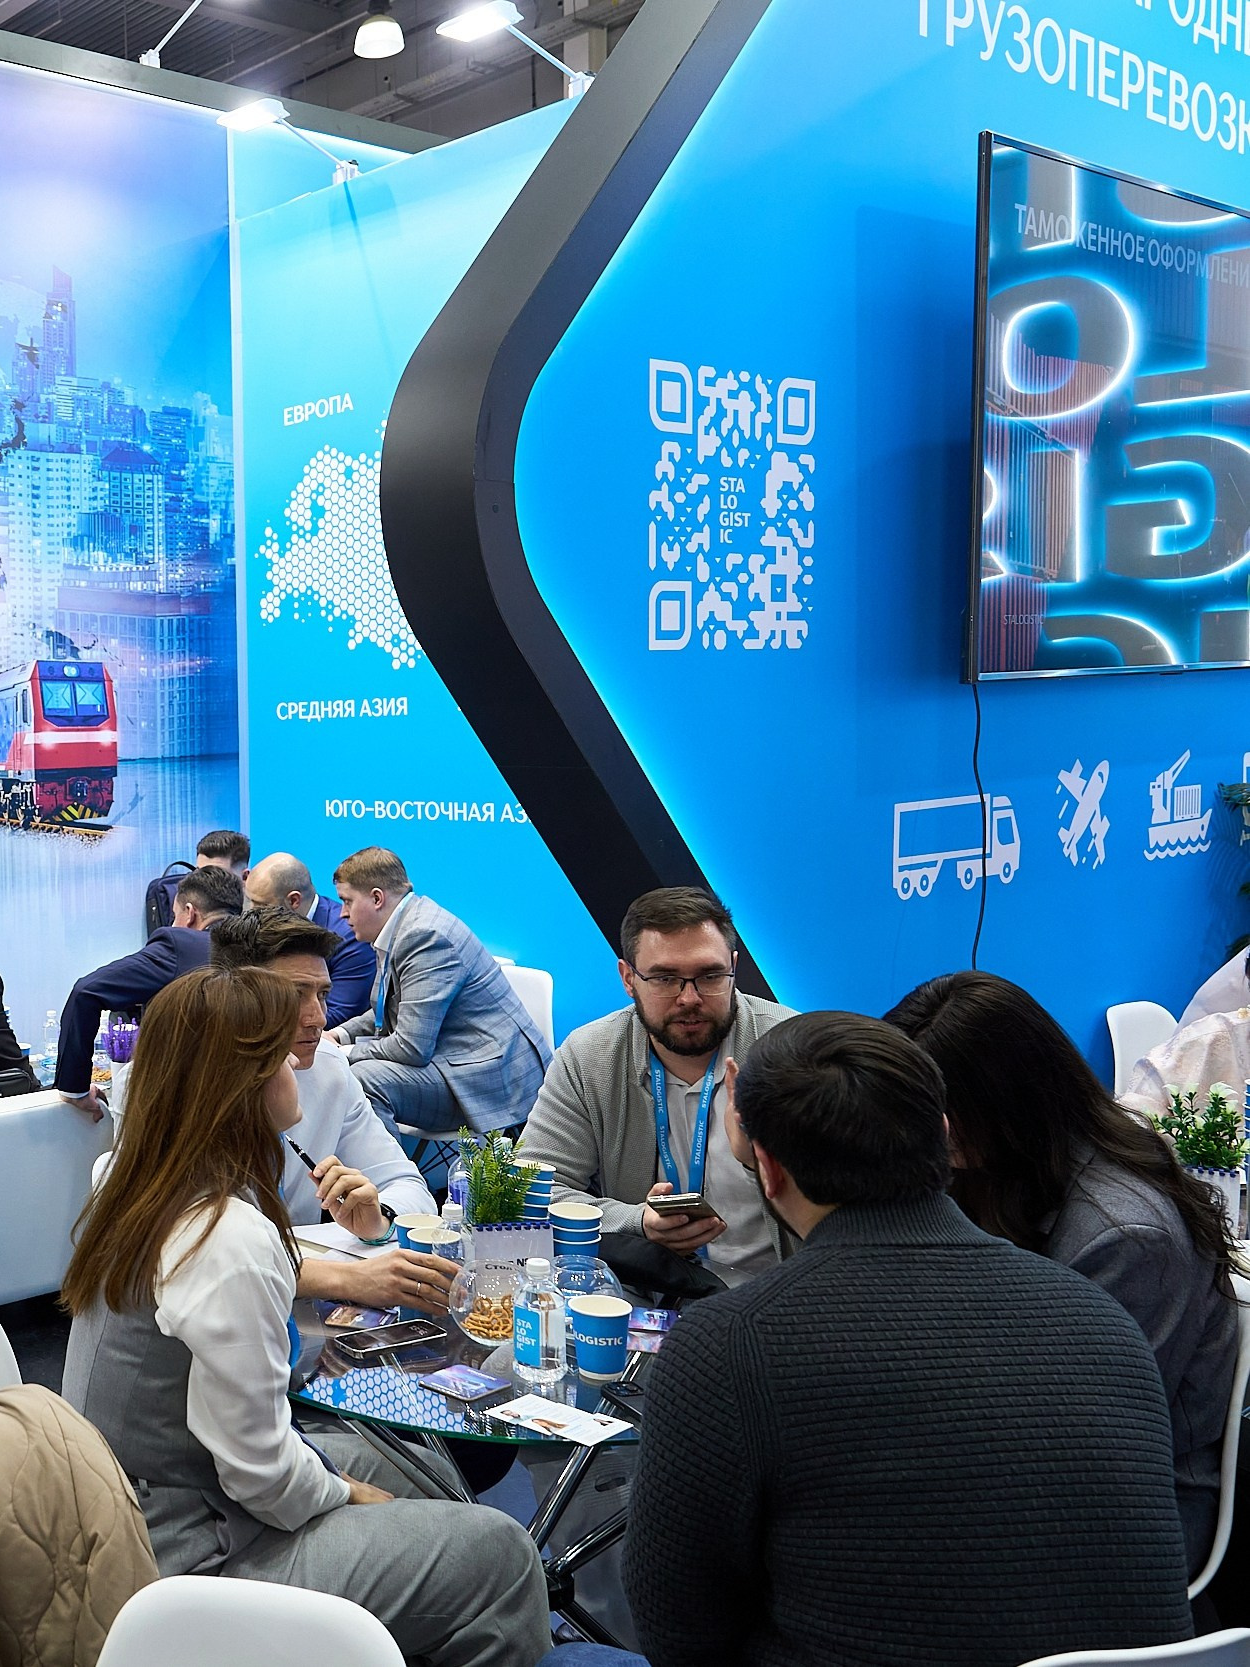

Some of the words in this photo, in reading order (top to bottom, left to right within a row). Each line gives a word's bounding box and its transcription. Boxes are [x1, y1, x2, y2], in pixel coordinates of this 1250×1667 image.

[283, 393, 354, 426] ЕВРОПА
[719, 477, 746, 493] STA
[719, 494, 738, 510] LO
[719, 511, 751, 527] GIST
[719, 529, 733, 544] IC
[276, 699, 356, 722] СРЕДНЯЯ
[359, 697, 409, 718] АЗИЯ
[324, 800, 495, 822] ЮГО-ВОСТОЧНАЯ
[500, 801, 532, 824] АЗ
[654, 1069, 664, 1113] STALOGISTIC
[659, 1125, 672, 1169] STALOGISTIC
[695, 1120, 705, 1166] STALOGISTIC
[516, 1318, 532, 1330] STA
[516, 1326, 527, 1336] LO
[516, 1334, 537, 1346] GIST
[516, 1342, 525, 1351] IC
[573, 1331, 623, 1347] LOGISTIC
